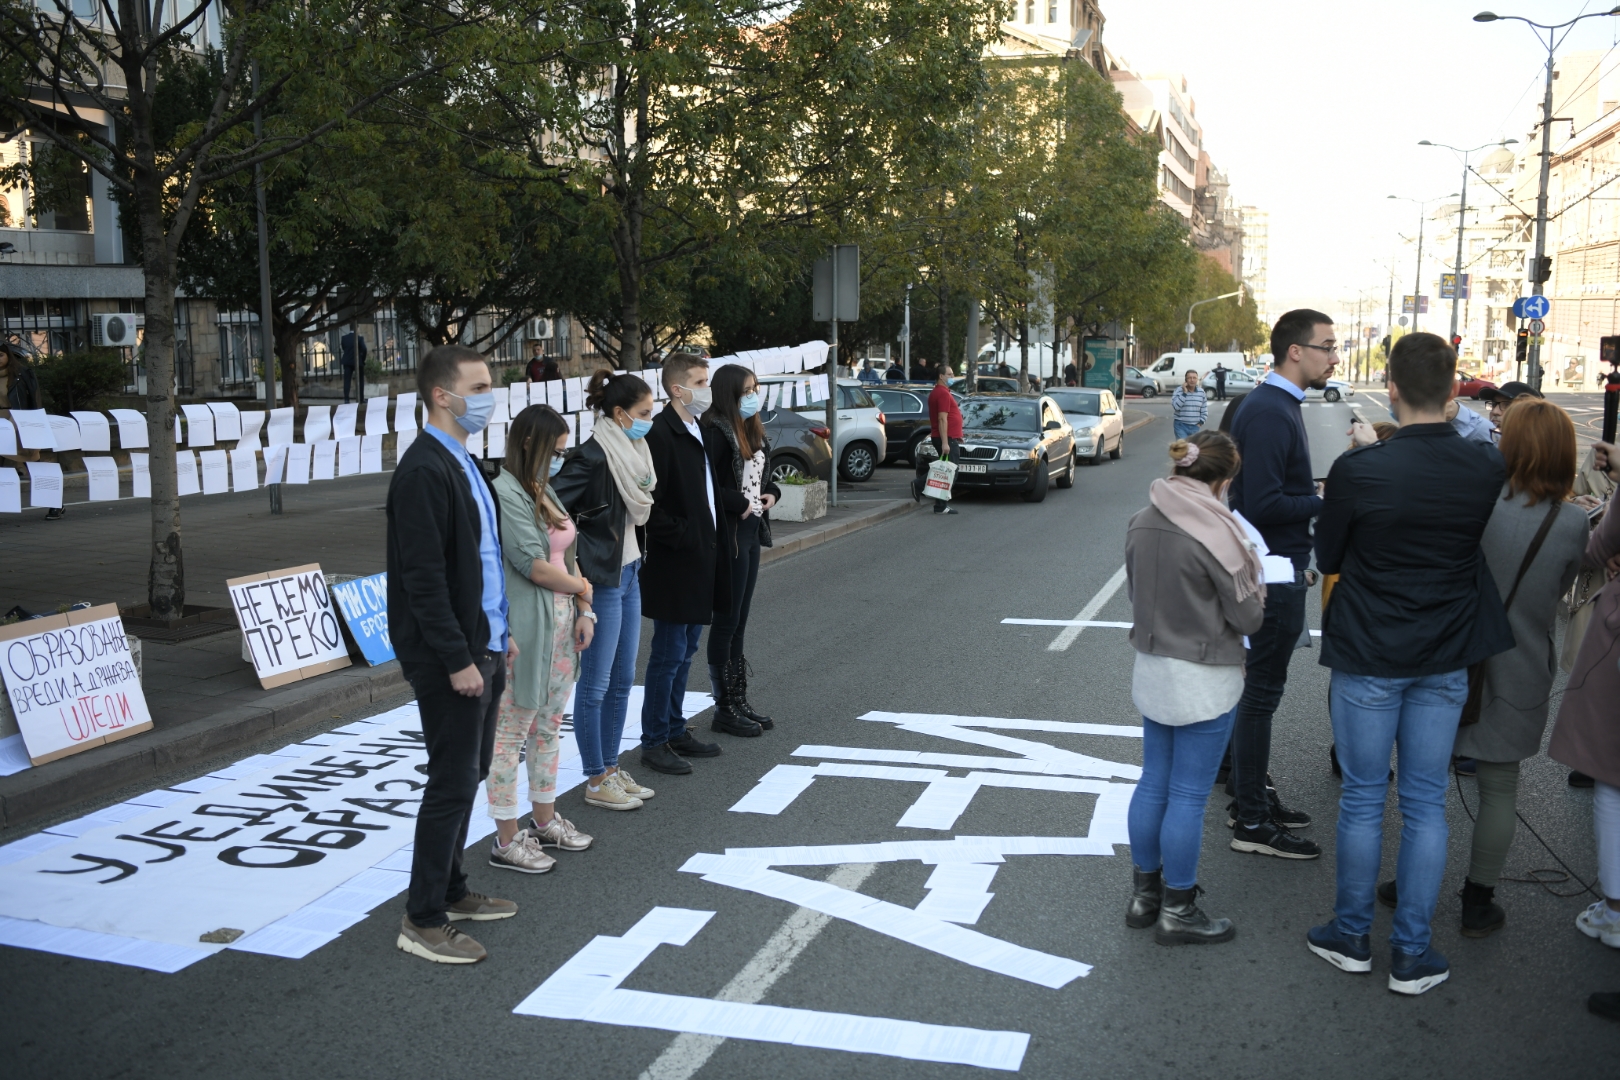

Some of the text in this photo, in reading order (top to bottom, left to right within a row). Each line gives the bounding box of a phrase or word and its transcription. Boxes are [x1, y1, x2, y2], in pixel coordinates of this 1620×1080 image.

[8, 620, 130, 682] ОБРАЗОВАЊЕ
[245, 610, 338, 671] ПРЕКО
[72, 672, 86, 696] А
[87, 660, 136, 692] ДРЖАВА
[60, 692, 134, 741] ШТЕДИ
